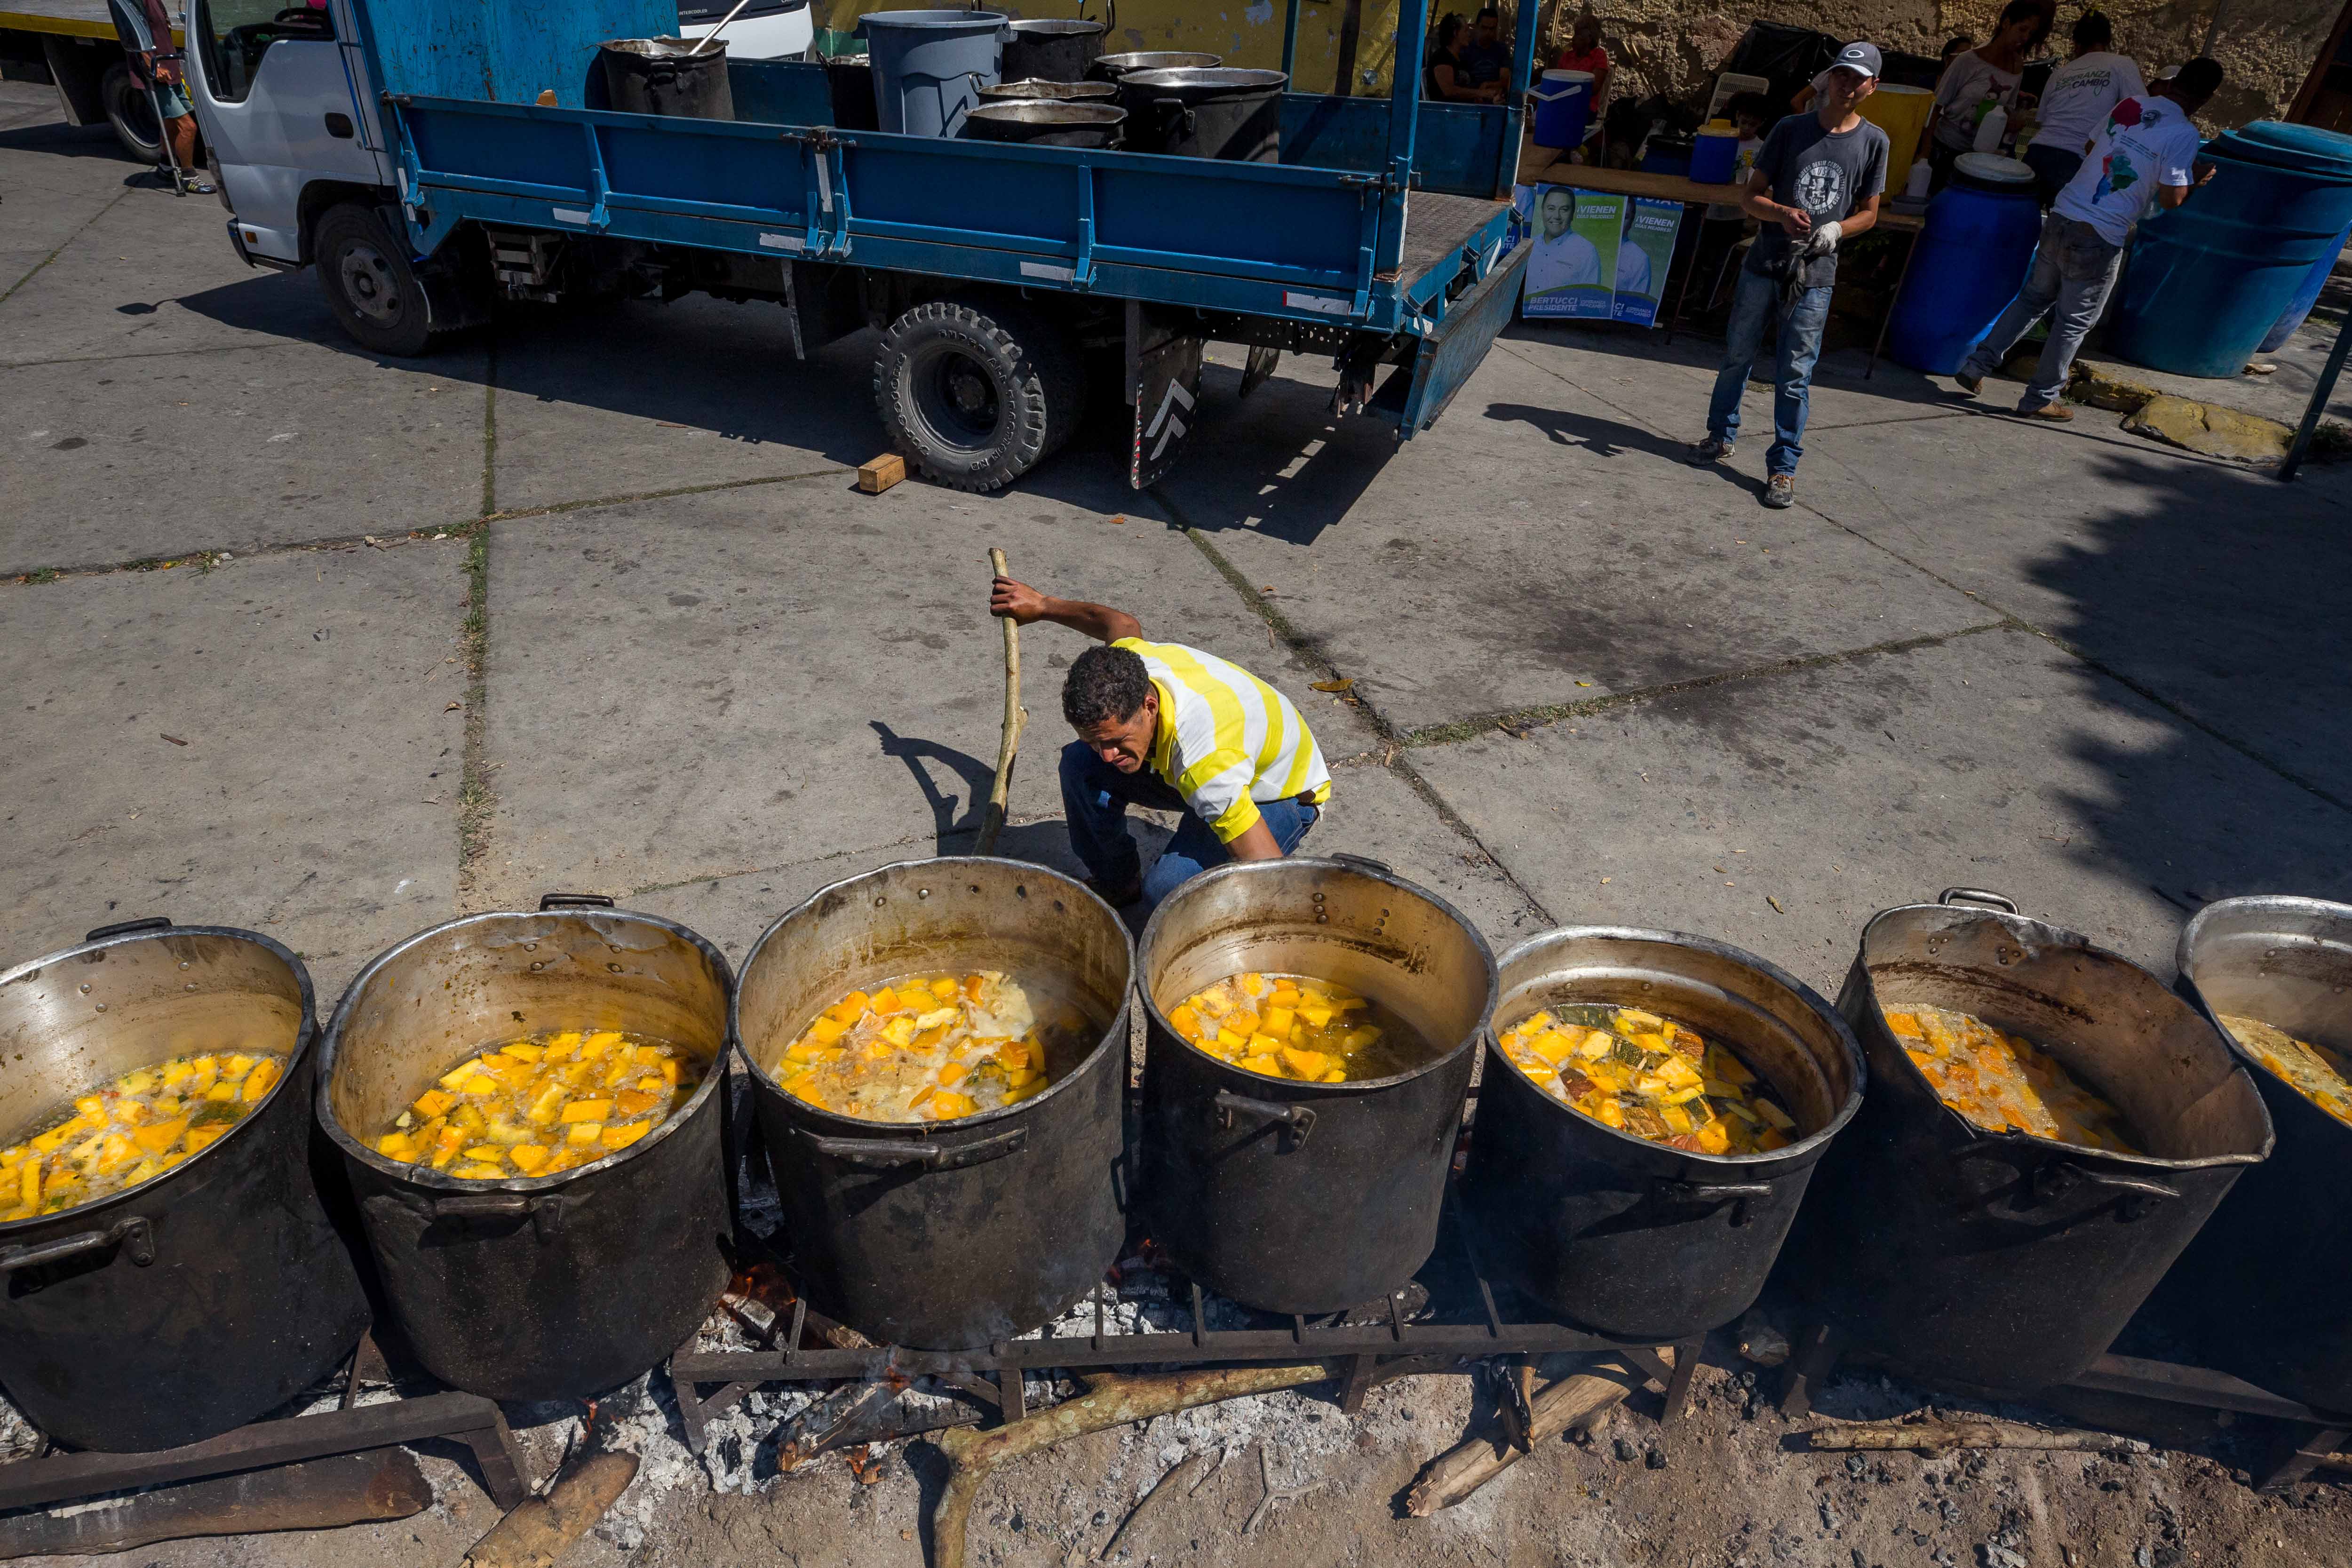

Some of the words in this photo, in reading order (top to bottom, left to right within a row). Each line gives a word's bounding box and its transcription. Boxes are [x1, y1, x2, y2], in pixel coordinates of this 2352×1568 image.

[2073, 79, 2110, 89] CAMBIO
[938, 328, 986, 355] SUPER
[990, 389, 1016, 462] TRACTION
[971, 458, 990, 471] ND
